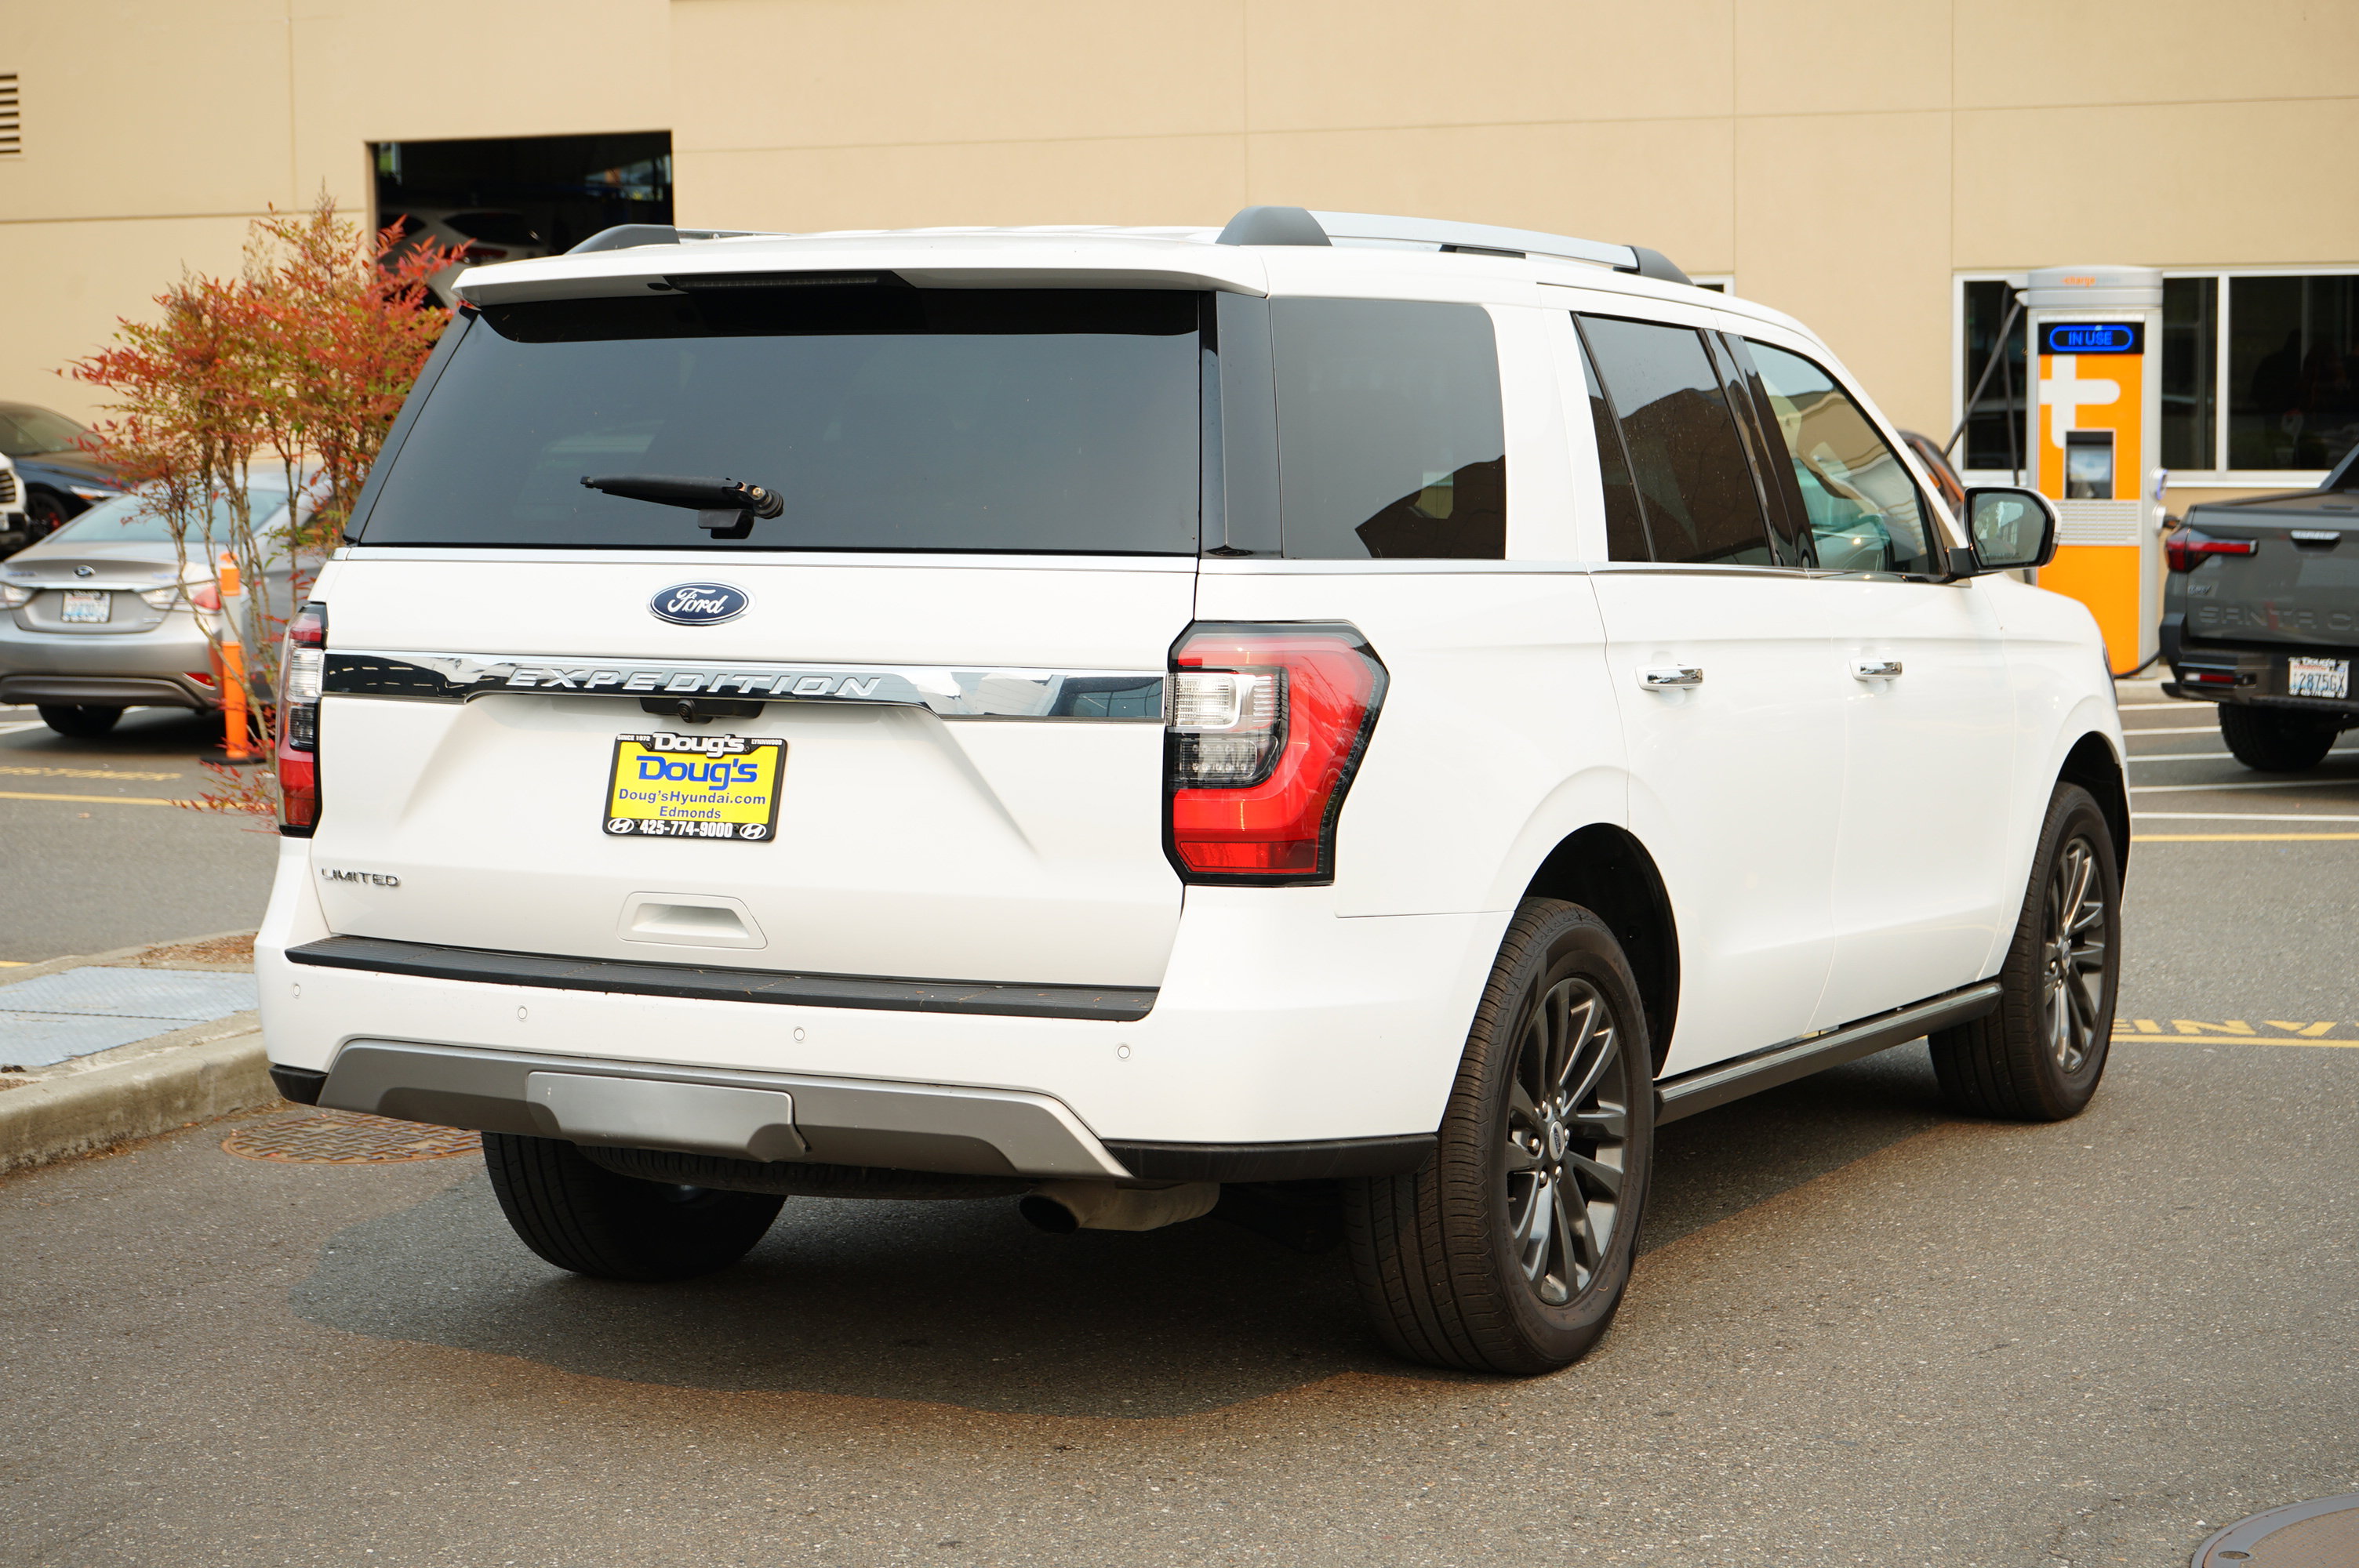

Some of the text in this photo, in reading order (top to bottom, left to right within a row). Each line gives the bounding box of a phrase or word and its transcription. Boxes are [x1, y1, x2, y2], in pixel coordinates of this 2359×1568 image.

[2068, 331, 2114, 346] IN USE
[667, 586, 729, 615] Ford
[504, 666, 882, 697] EXPEDITION
[652, 732, 745, 758] Doug's
[636, 755, 758, 791] Doug's
[619, 788, 766, 805] Doug'sHyundai.com
[659, 806, 722, 819] Edmonds
[639, 819, 734, 838] 425-774-9000
[321, 867, 402, 887] LIMITED
